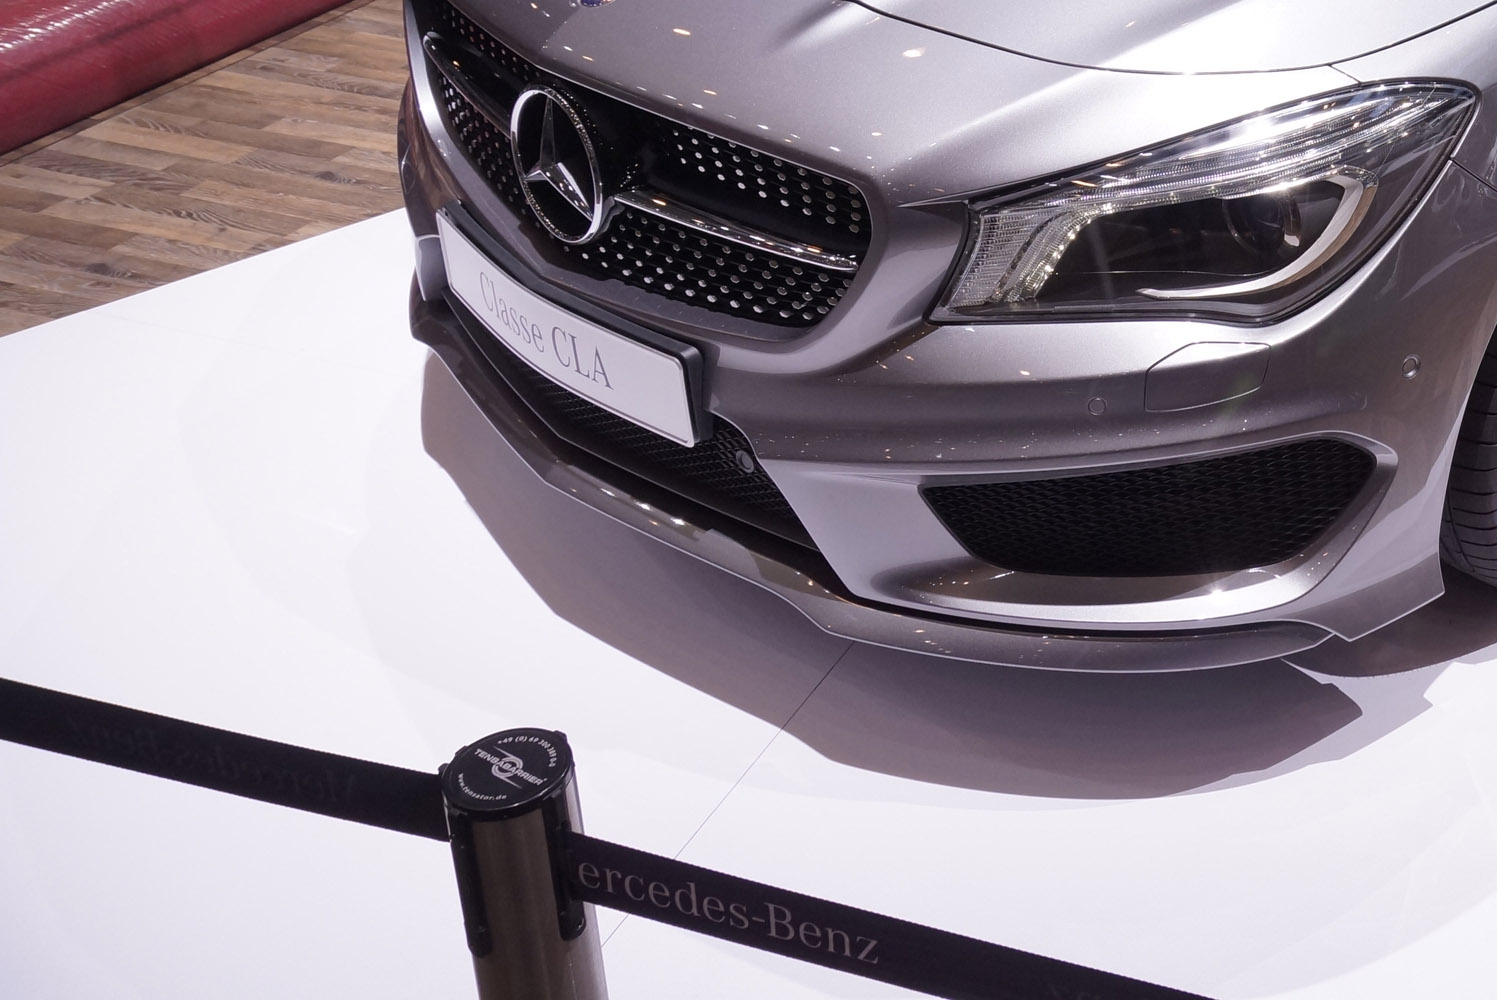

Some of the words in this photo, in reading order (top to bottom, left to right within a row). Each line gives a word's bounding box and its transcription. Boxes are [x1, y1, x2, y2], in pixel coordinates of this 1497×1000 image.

[479, 271, 545, 353] Classe
[551, 326, 614, 391] CLA
[577, 861, 880, 964] ercedes-Benz
